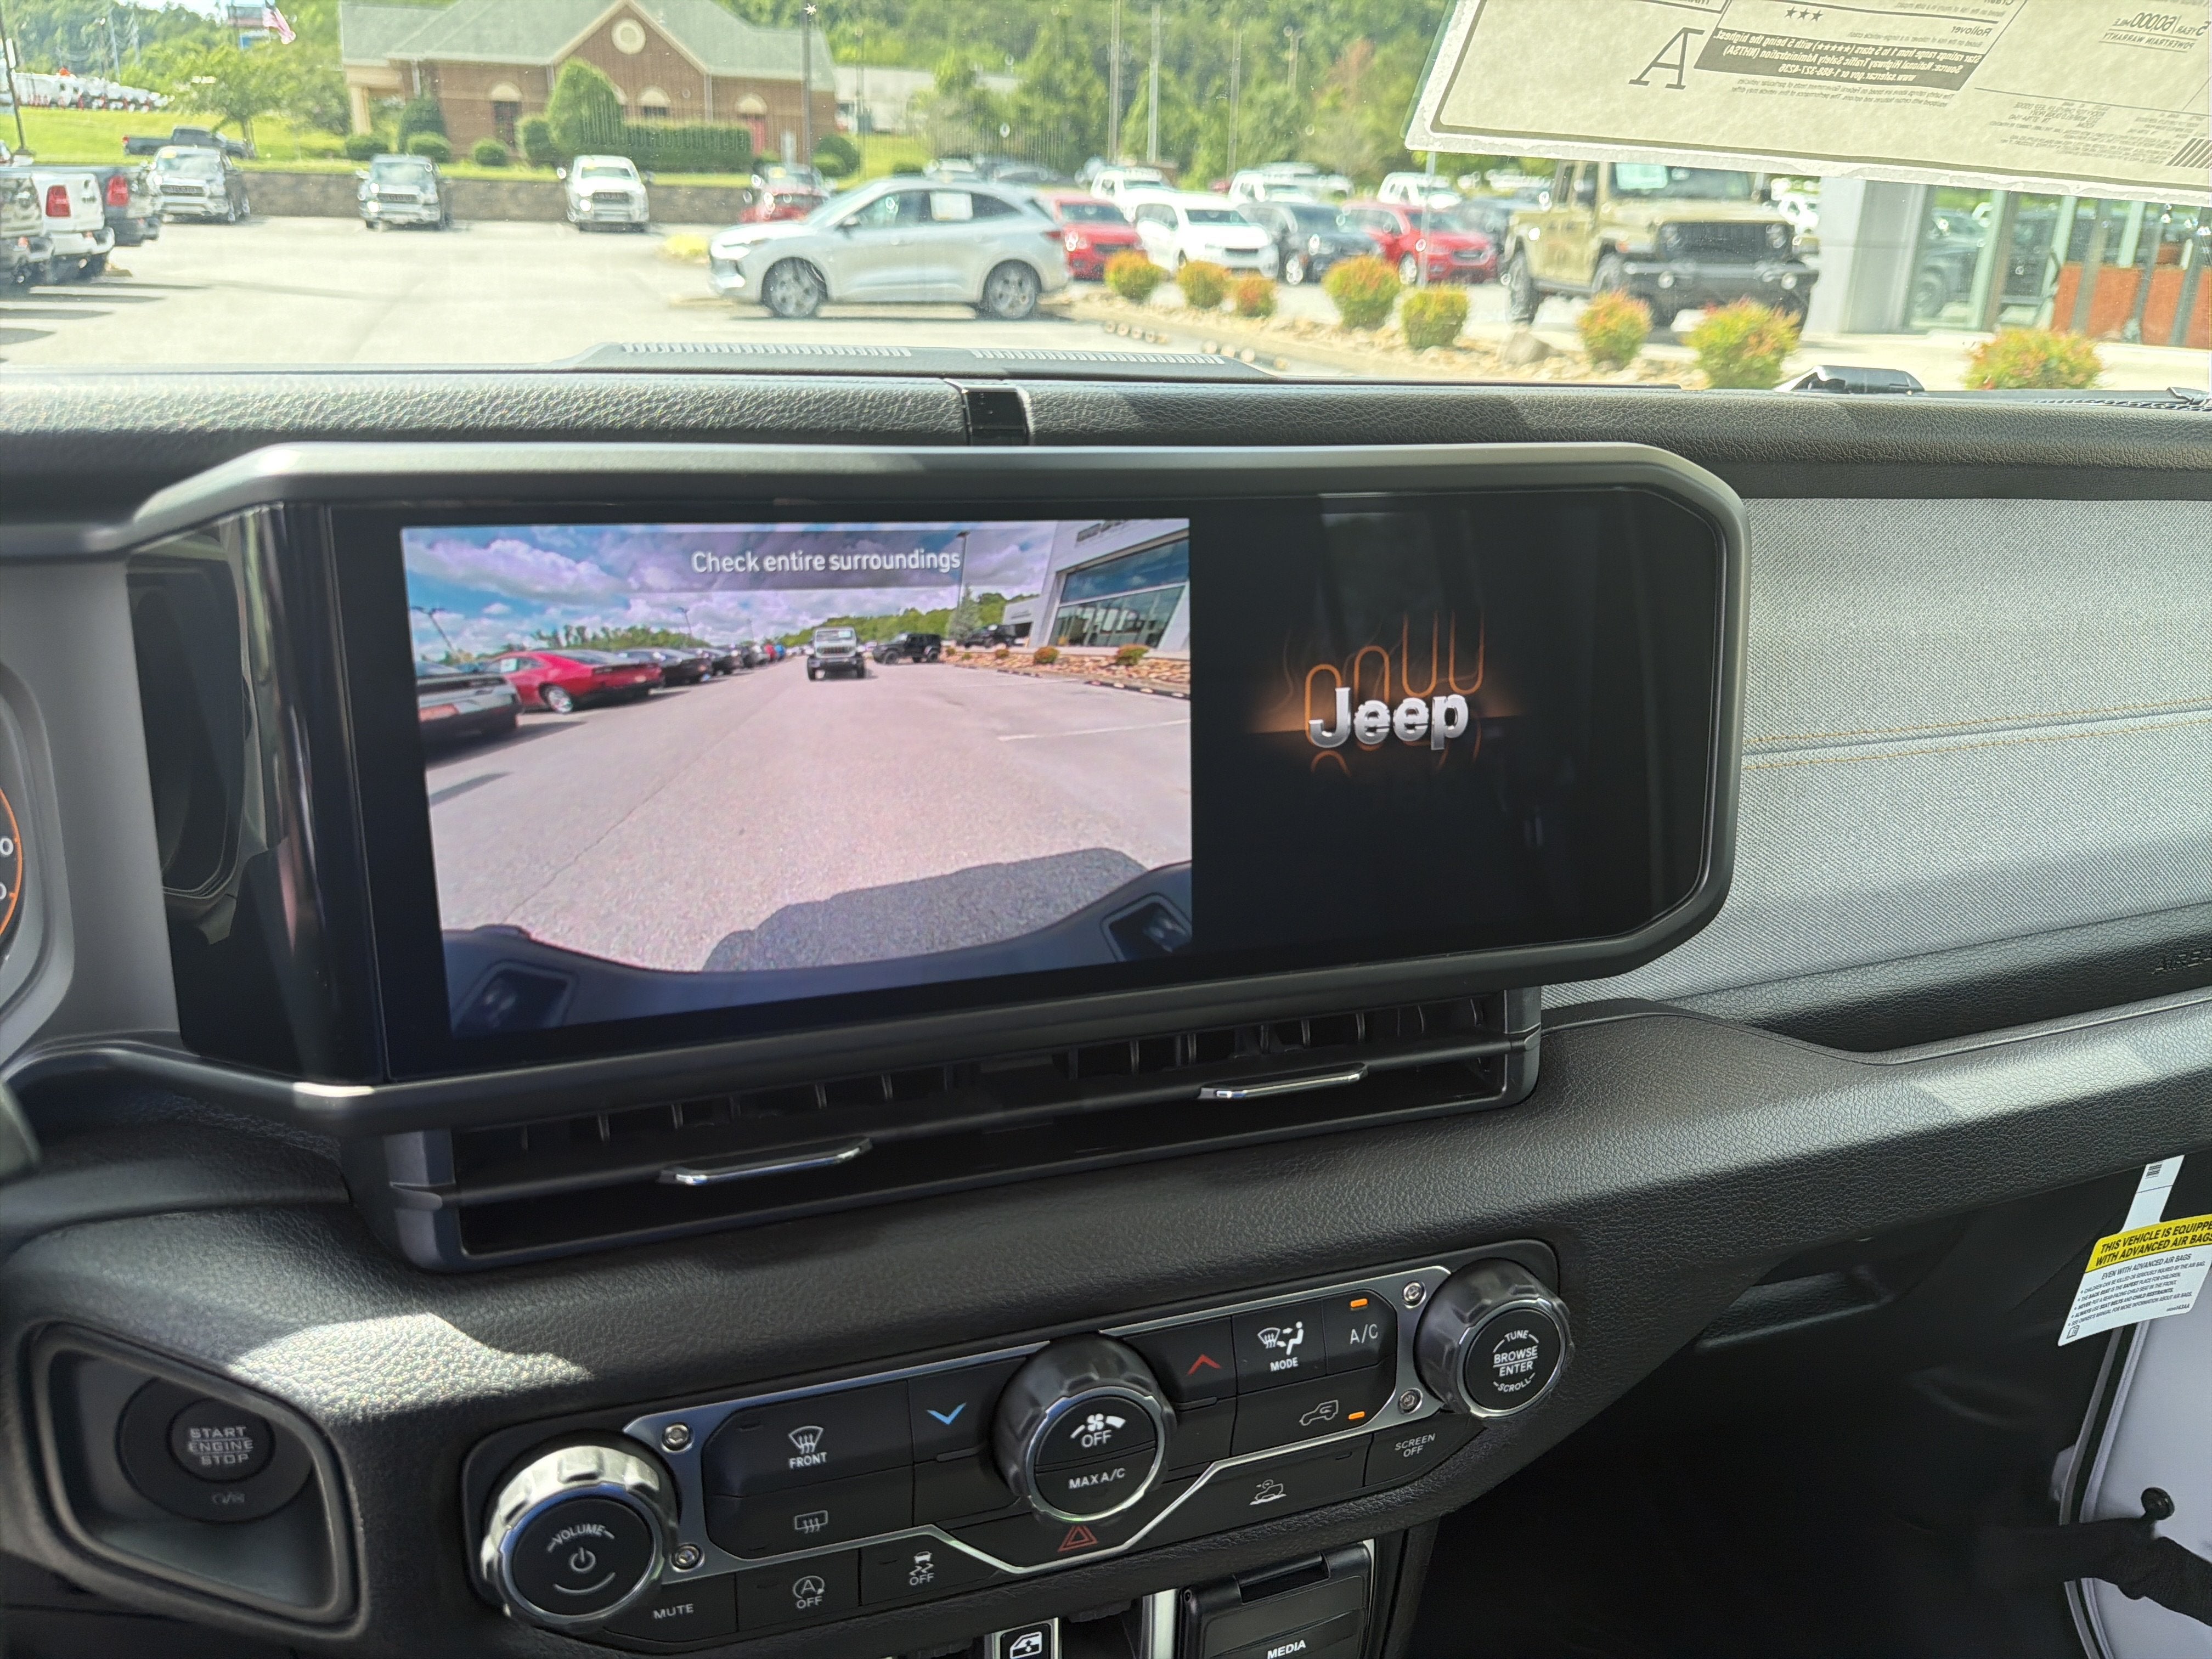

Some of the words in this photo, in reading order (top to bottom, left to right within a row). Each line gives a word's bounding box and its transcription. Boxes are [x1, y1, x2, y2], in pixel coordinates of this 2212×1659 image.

[691, 550, 760, 573] Check
[763, 551, 825, 572] entire
[828, 549, 961, 573] surroundings
[1308, 687, 1468, 751] Jeep
[2101, 1239, 2121, 1254] THIS
[2122, 1229, 2160, 1247] VEHICLE
[2162, 1227, 2172, 1238] IS
[2096, 1251, 2119, 1267] WITH
[2119, 1239, 2170, 1260] ADVANCED
[2170, 1235, 2188, 1248] AIR
[2101, 1270, 2117, 1280] EVEN
[2117, 1266, 2132, 1274] WITH
[2132, 1259, 2164, 1271] ADVANCED
[2175, 1254, 2192, 1262] BAGS
[1350, 1323, 1378, 1344] A/C
[1504, 1330, 1529, 1342] TUNE
[1494, 1345, 1538, 1364] BROWSE
[1270, 1357, 1299, 1372] MODE
[1499, 1361, 1533, 1377] ENTER
[1497, 1378, 1532, 1392] SCROLL
[190, 1425, 246, 1438] START
[1081, 1429, 1112, 1448] OFF
[188, 1440, 253, 1452] ENGINE
[1395, 1432, 1436, 1451] SCREEN
[1403, 1445, 1424, 1457] OFF
[201, 1454, 249, 1466] STOP
[789, 1452, 827, 1469] FRONT
[1069, 1474, 1098, 1489] MAX
[1101, 1468, 1126, 1483] A/C
[553, 1523, 606, 1545] VOLUME
[800, 1579, 816, 1595] A
[910, 1572, 934, 1585] OFF
[653, 1604, 694, 1618] MUTE
[797, 1596, 822, 1609] OFF
[1267, 1640, 1306, 1659] MEDIA
